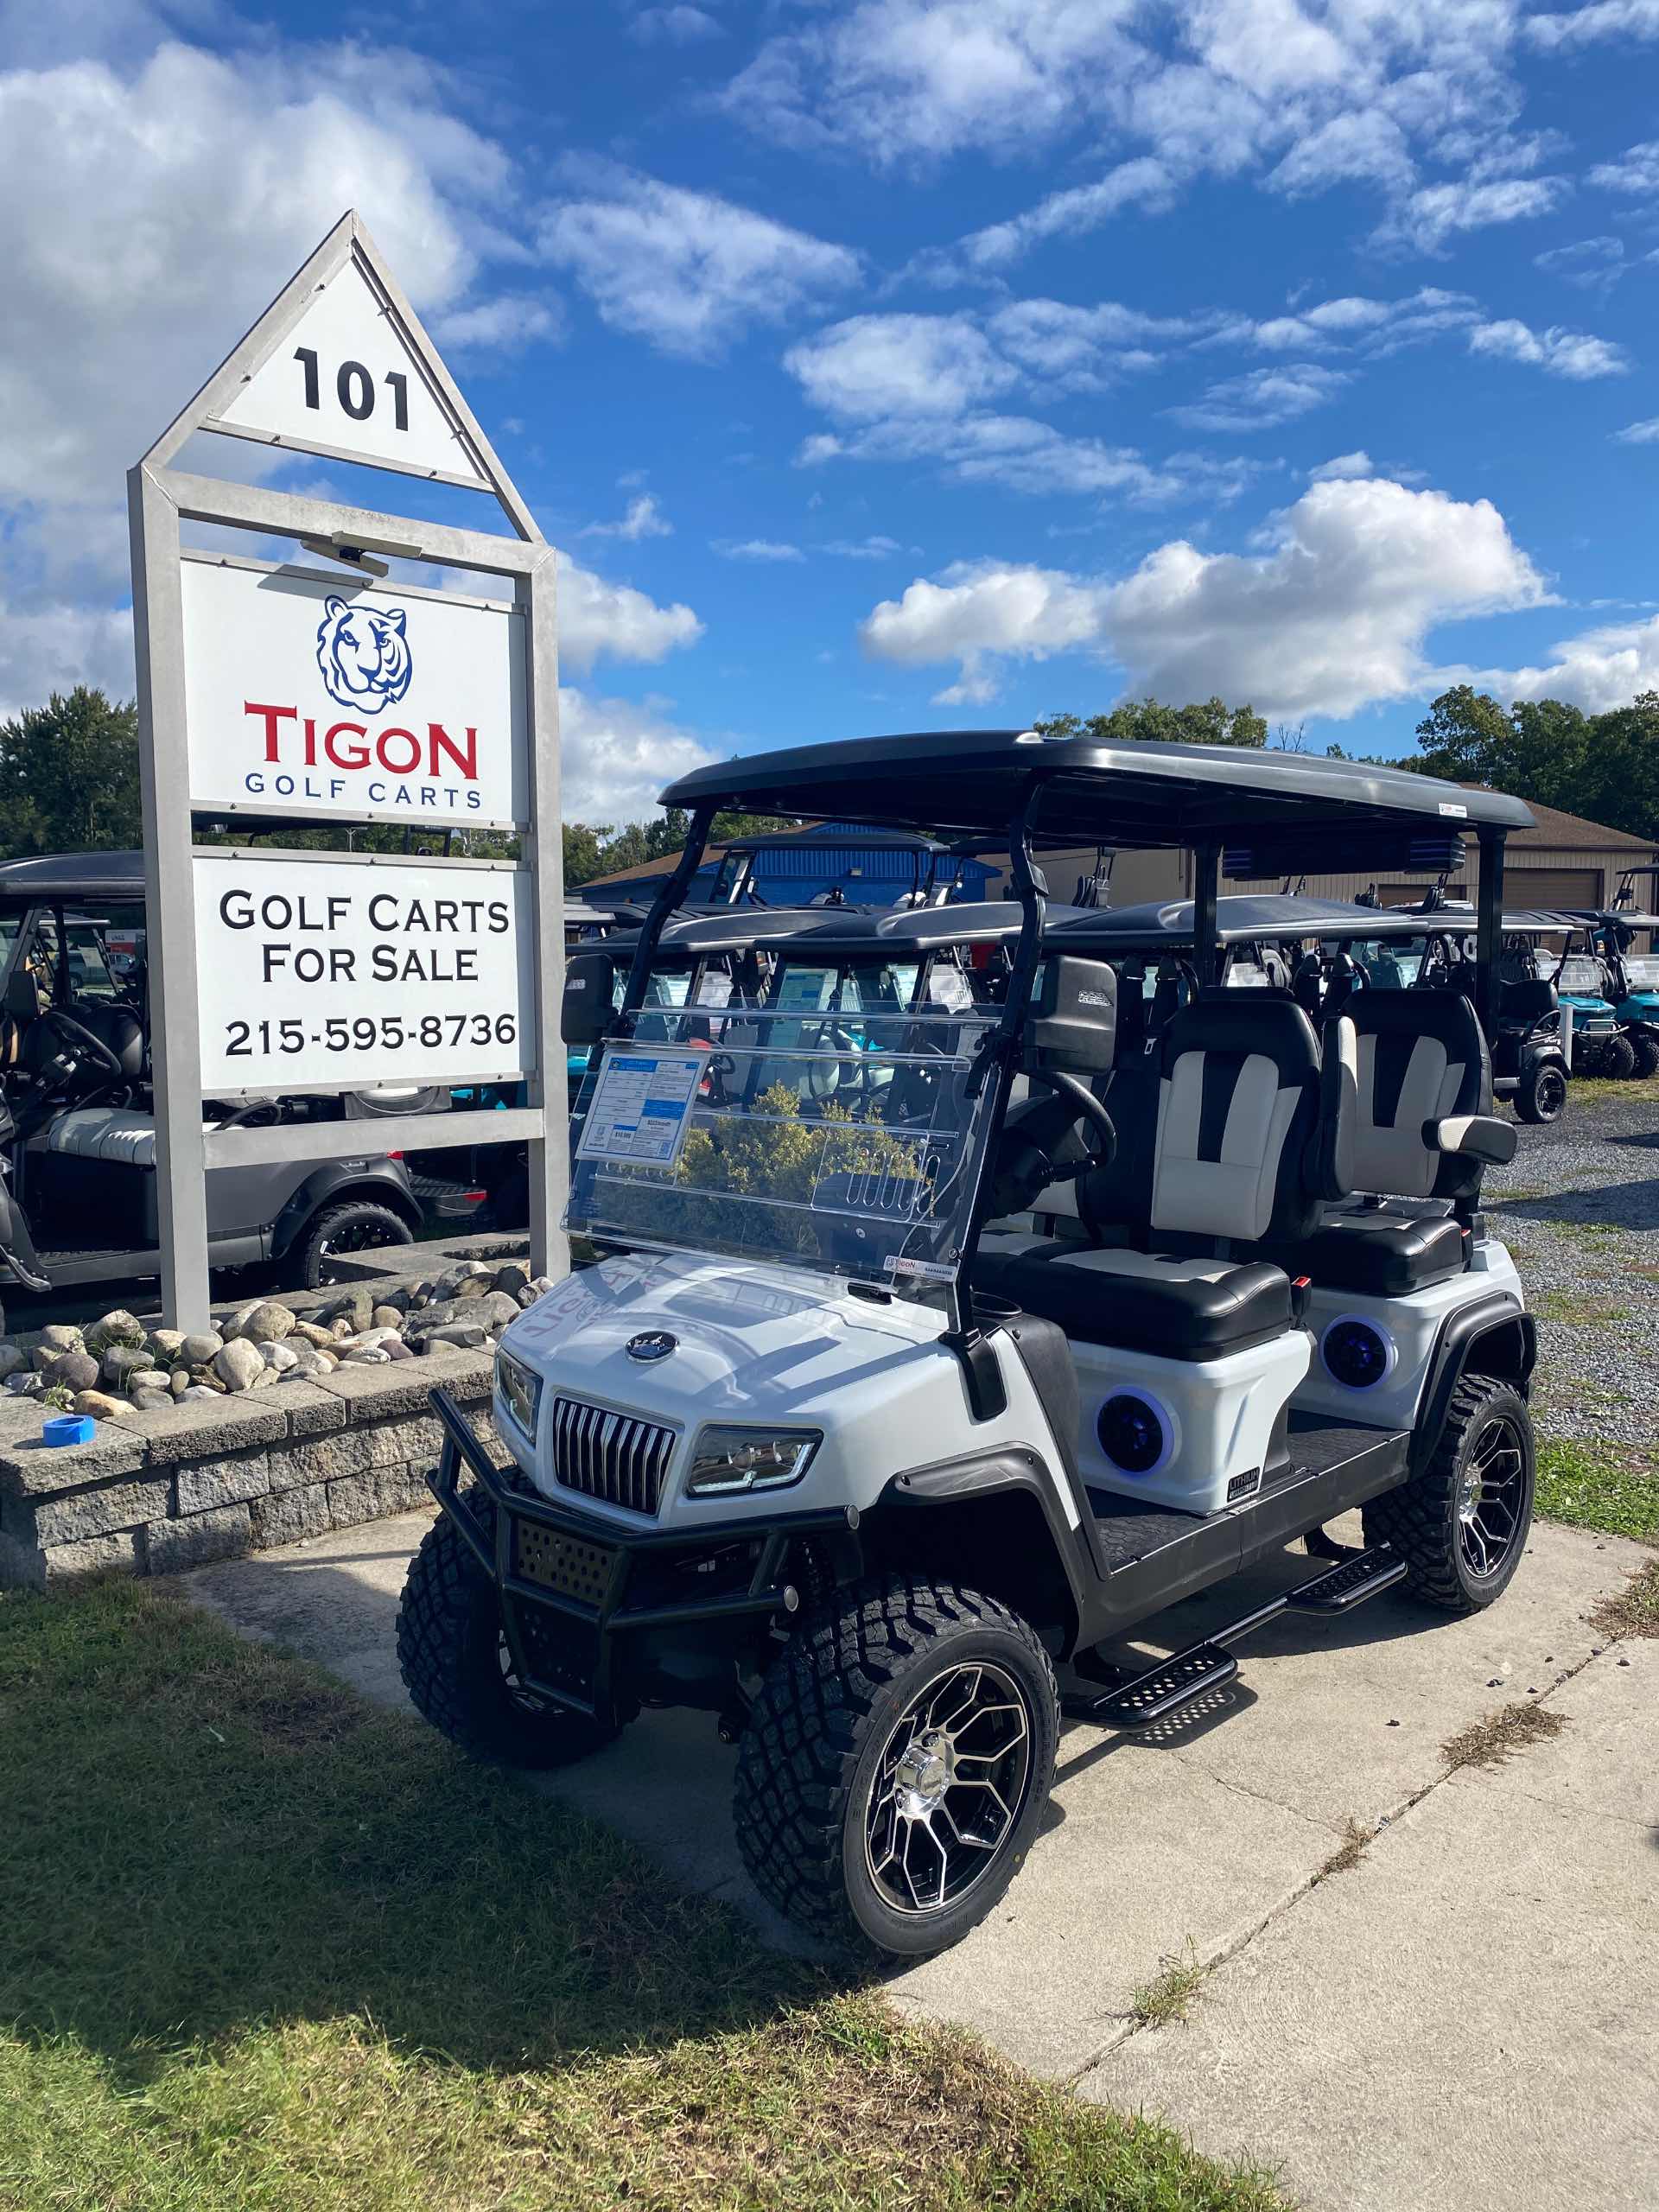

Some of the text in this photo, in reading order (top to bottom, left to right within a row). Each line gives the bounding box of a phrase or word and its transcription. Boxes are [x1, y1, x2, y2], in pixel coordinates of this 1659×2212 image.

[293, 346, 409, 432] 101
[244, 699, 480, 780] TIGON
[245, 772, 480, 809] GOLF CARTS
[219, 889, 509, 933] GOLF CARTS
[261, 942, 479, 982] FOR SALE
[225, 1014, 516, 1057] 215-595-8736
[1230, 1468, 1259, 1491] LITHIUM
